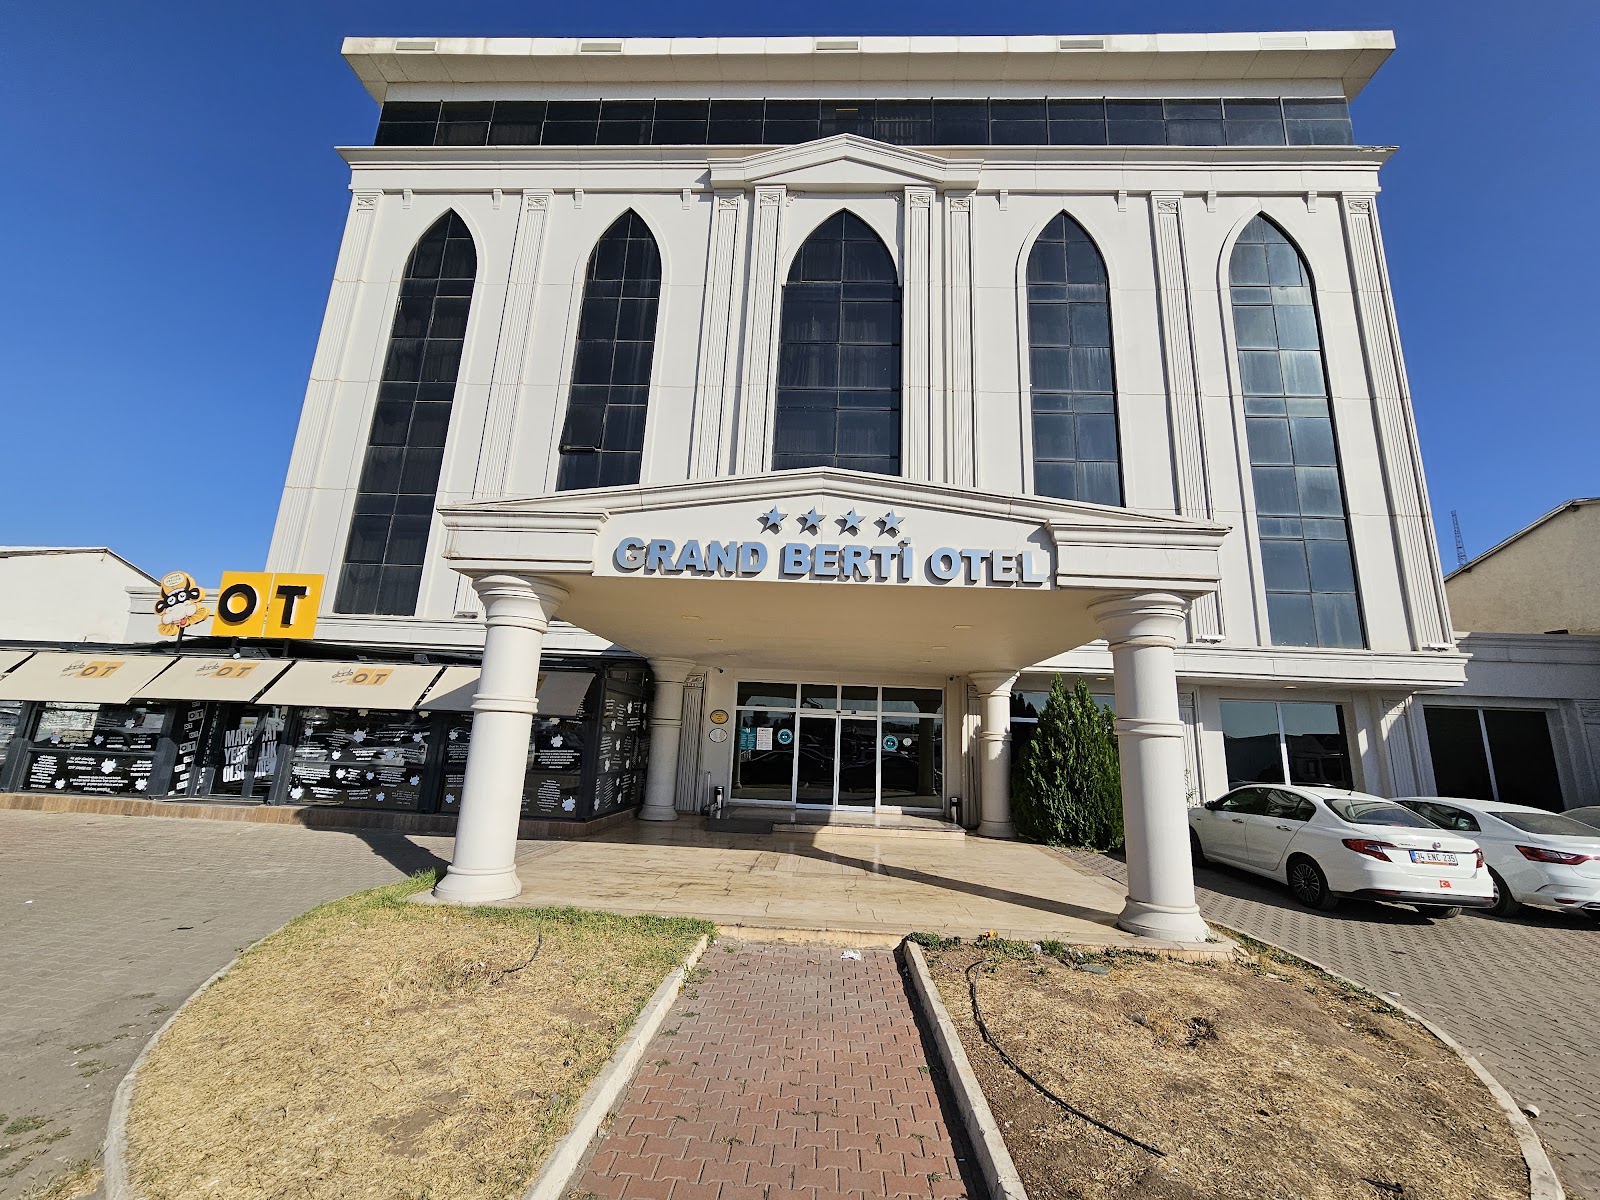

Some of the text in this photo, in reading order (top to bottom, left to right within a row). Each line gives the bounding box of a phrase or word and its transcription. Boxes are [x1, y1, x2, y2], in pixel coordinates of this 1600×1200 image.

[614, 536, 1049, 584] GRAND BERTİ OTEL
[218, 583, 309, 626] OT
[80, 665, 117, 677] OT
[215, 666, 252, 677] OT
[352, 672, 387, 684] OT
[188, 710, 203, 720] OT
[180, 742, 195, 752] OT
[1416, 852, 1425, 860] 34
